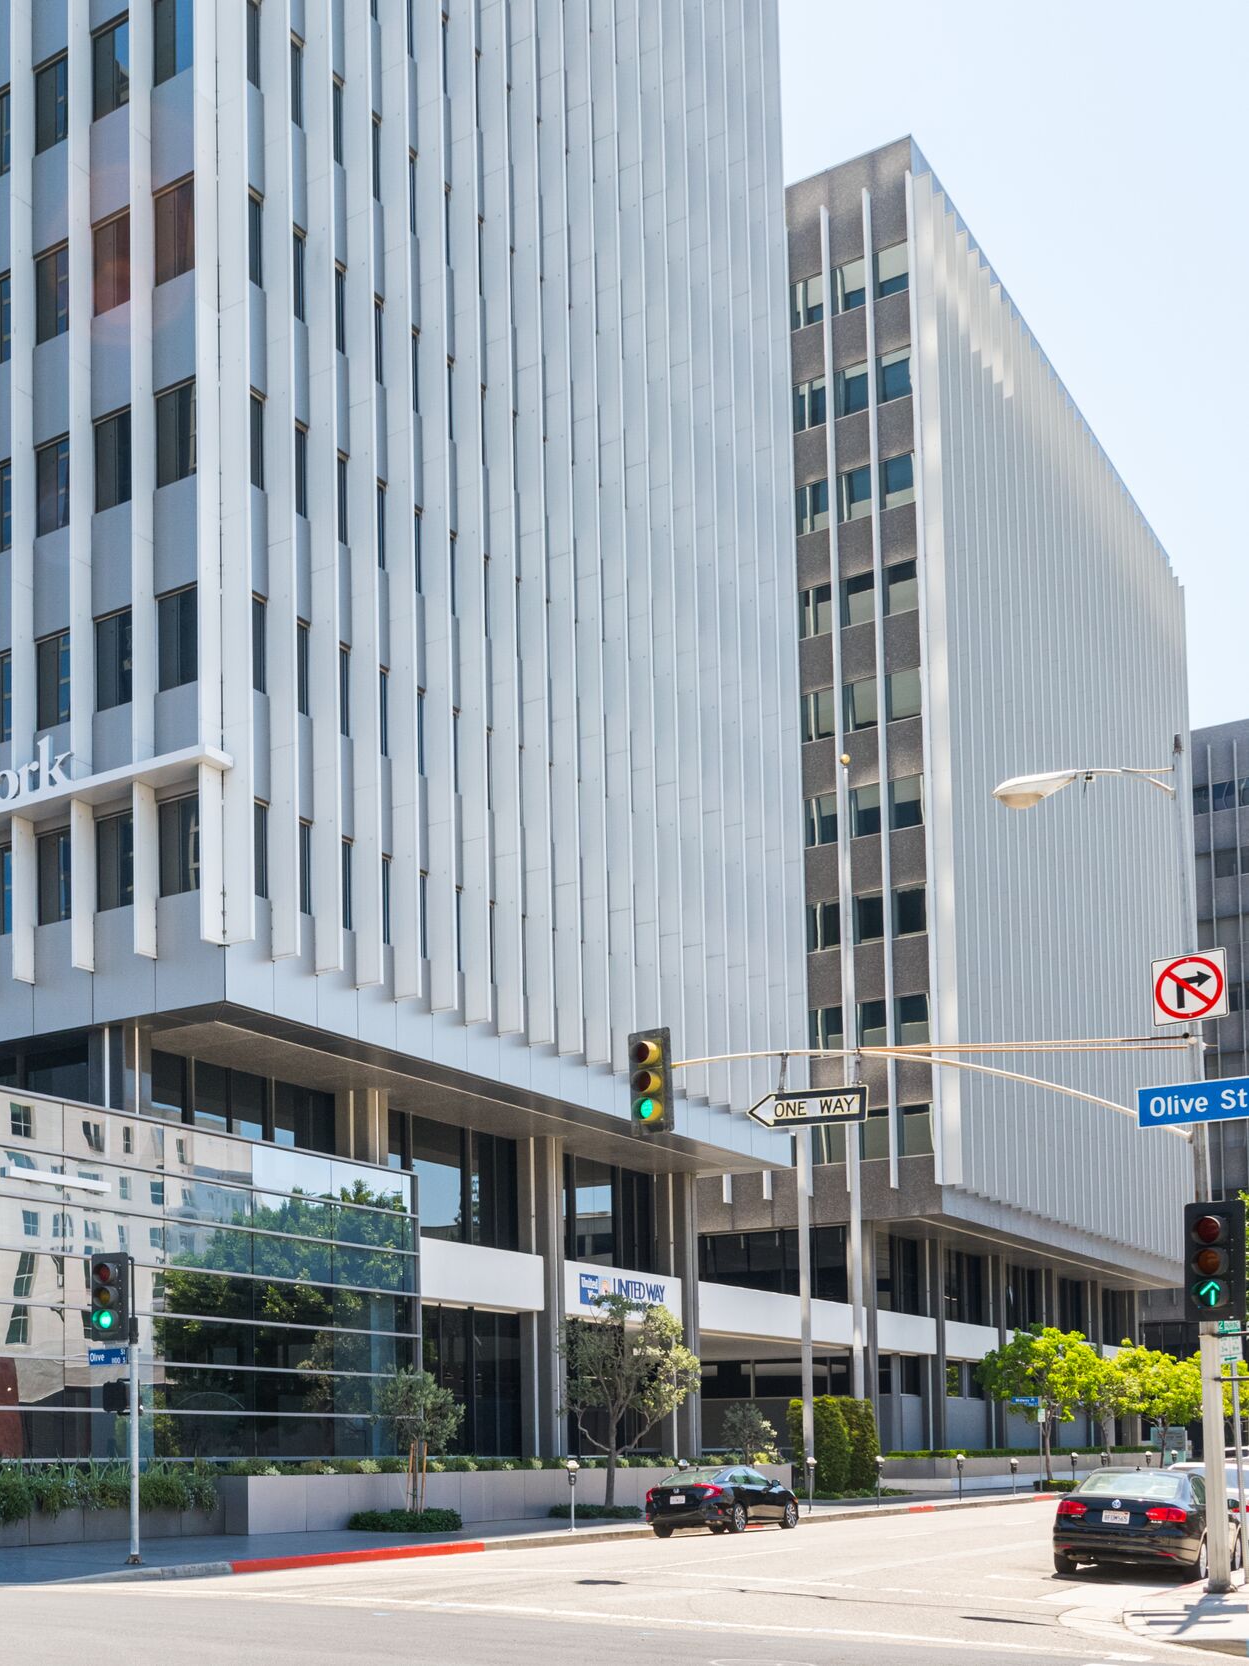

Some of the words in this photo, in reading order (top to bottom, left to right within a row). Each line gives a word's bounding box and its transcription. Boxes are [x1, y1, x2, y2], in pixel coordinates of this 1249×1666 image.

[774, 1100, 807, 1118] ONE
[819, 1096, 856, 1114] WAY
[1149, 1094, 1209, 1118] Olive
[1220, 1087, 1249, 1110] St
[613, 1278, 646, 1300] UNITED
[645, 1282, 665, 1303] WAY
[89, 1352, 105, 1362] Olive
